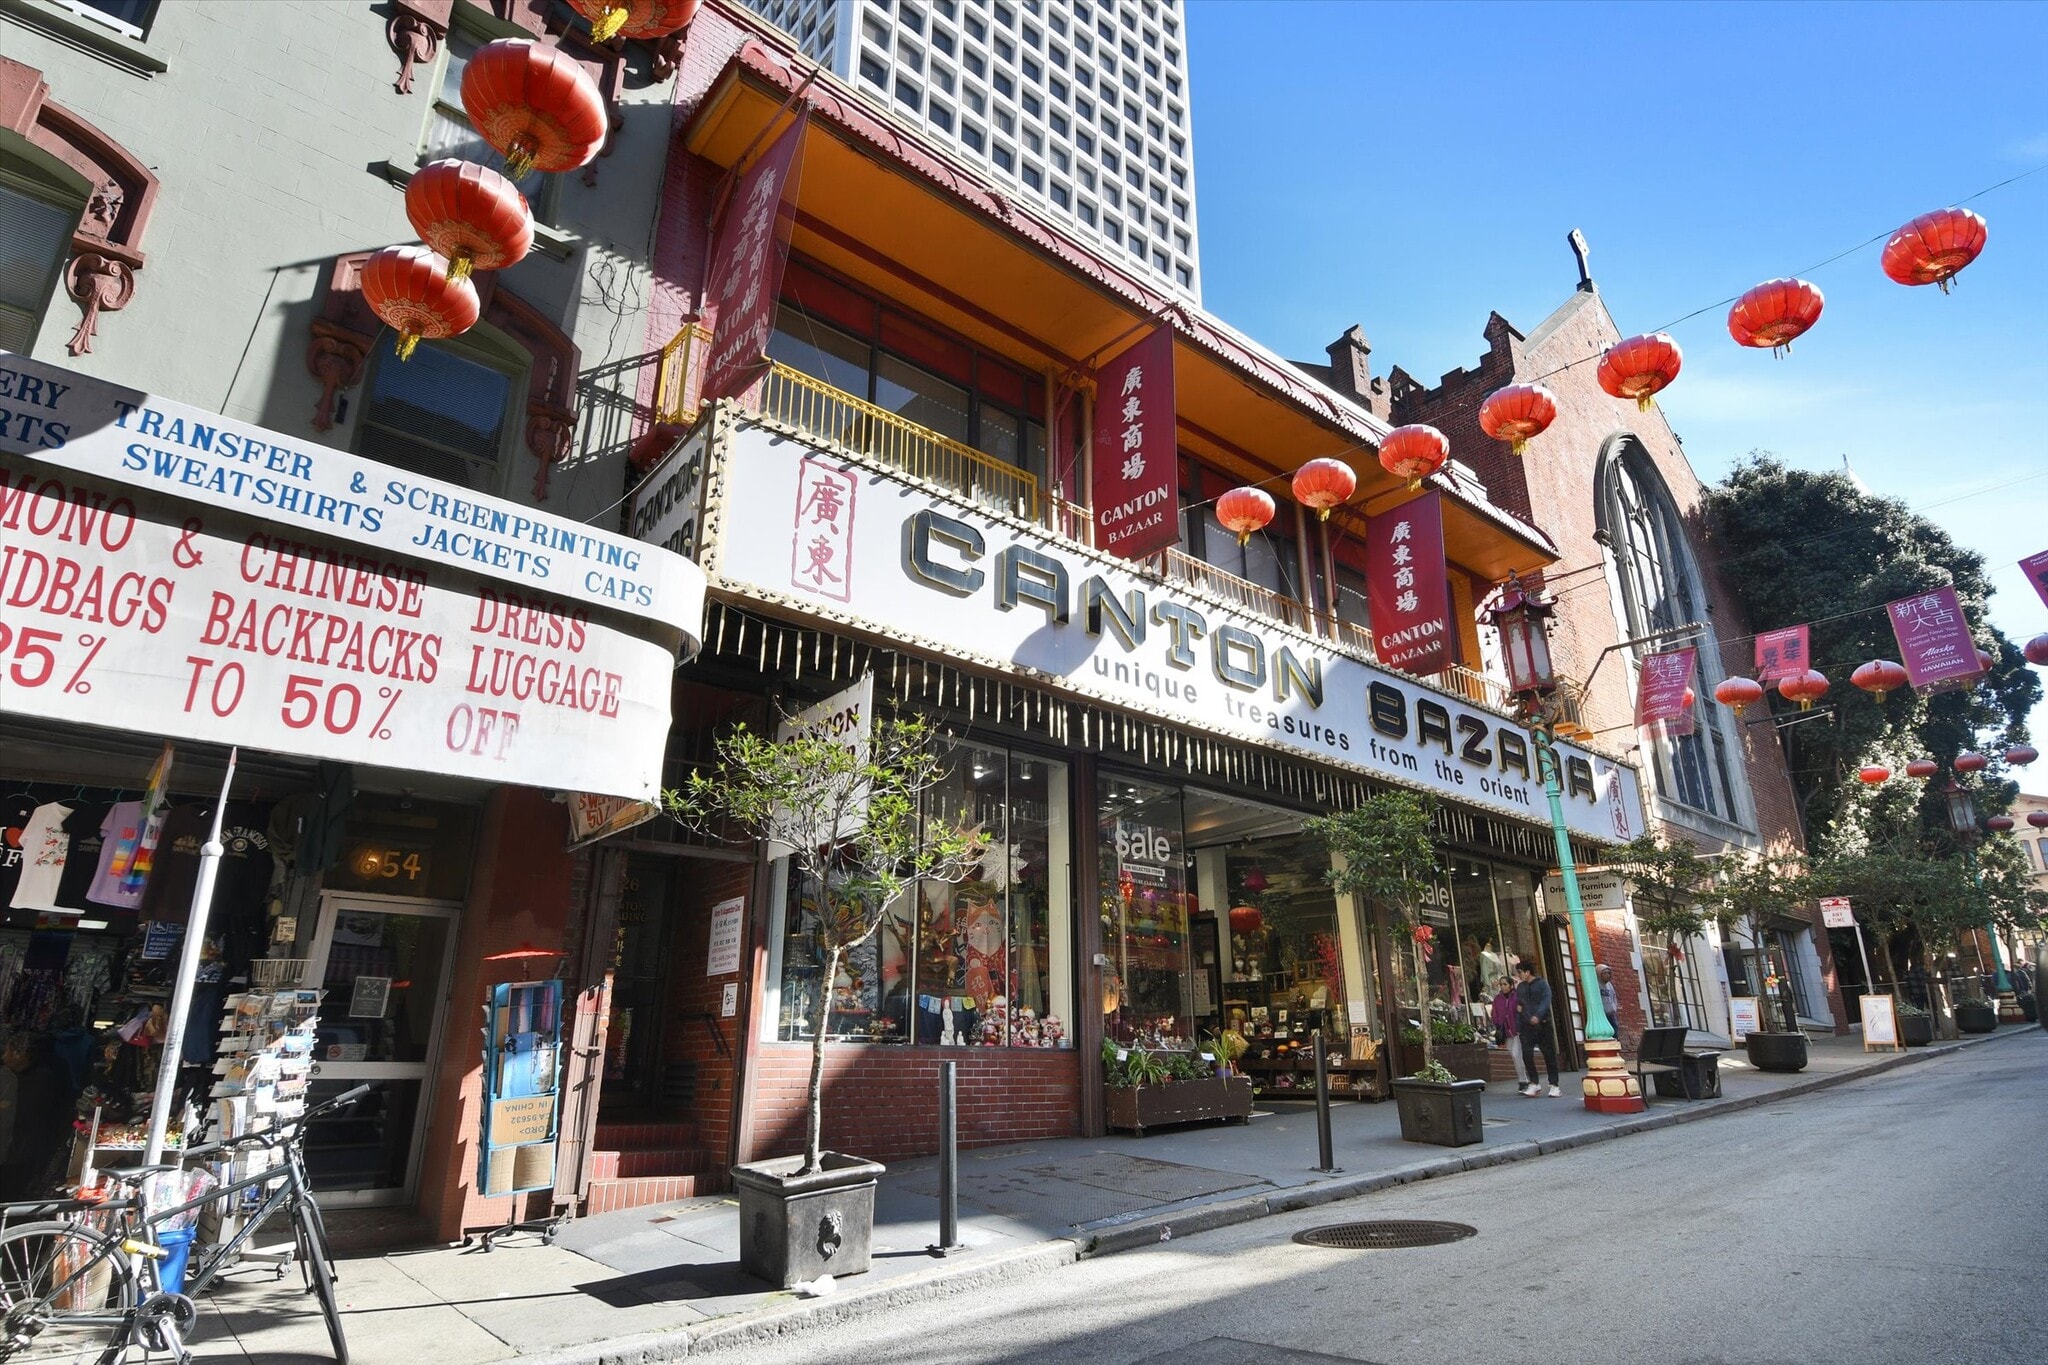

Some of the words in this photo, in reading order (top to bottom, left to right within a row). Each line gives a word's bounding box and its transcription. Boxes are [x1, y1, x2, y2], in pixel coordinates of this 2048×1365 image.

[1121, 366, 1146, 480] 廣東商場
[113, 400, 314, 481] TRANSFER
[349, 471, 367, 494] &
[384, 480, 641, 572] SCREENPRINTING
[1101, 484, 1168, 526] CANTON
[122, 443, 383, 533] SWEATSHIRTS
[412, 524, 551, 578] JACKETS
[585, 571, 653, 607] CAPS
[801, 475, 845, 586] 廣東
[1108, 512, 1163, 544] BAZAAR
[173, 517, 204, 569] &
[240, 531, 428, 619] CHINESE
[471, 587, 590, 653] DRESS
[1390, 521, 1418, 612] 廣東商場
[906, 508, 1323, 709] CANTON
[1895, 594, 1942, 618] 新春
[1909, 608, 1953, 632] 大吉
[1382, 618, 1443, 649] CANTON
[1391, 640, 1442, 664] BAZAAR
[1920, 644, 1955, 658] Alaska
[200, 590, 442, 684] BACKPACKS
[466, 644, 622, 719] LUGGAGE
[1920, 658, 1964, 673] HAWAIIAN
[184, 655, 245, 718] TO
[281, 674, 403, 740] 50%
[446, 702, 521, 762] OFF
[1094, 655, 1198, 703] unique
[1225, 692, 1350, 750] treasures
[1370, 738, 1418, 772] from
[1434, 759, 1464, 785] the
[1480, 777, 1530, 806] orient
[1115, 826, 1170, 862] sale
[1581, 882, 1617, 891] Furniture
[505, 1103, 534, 1112] CHINA
[511, 1115, 537, 1124] 95632
